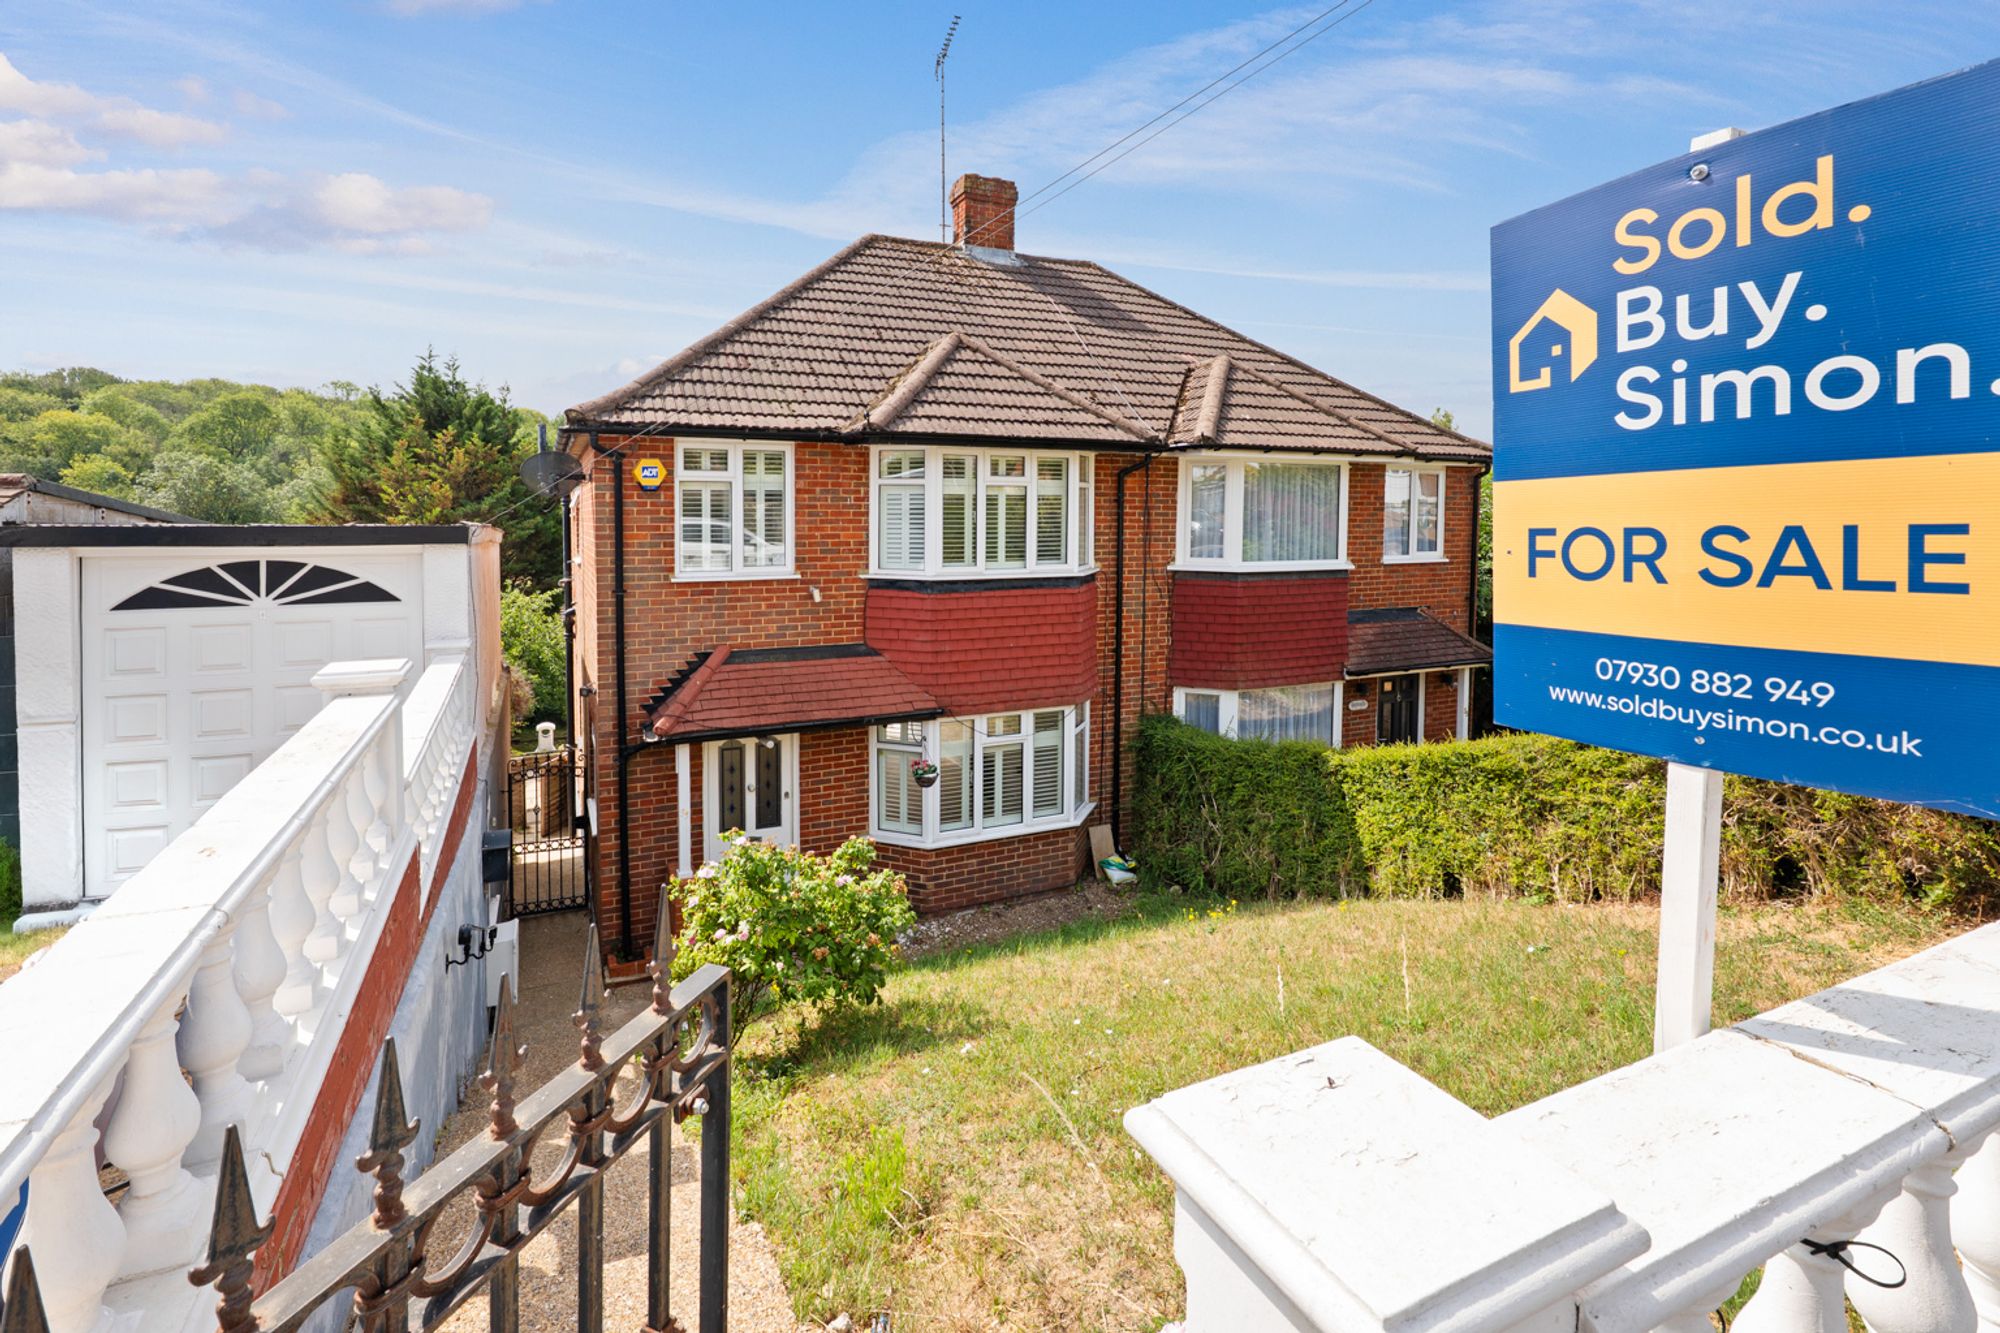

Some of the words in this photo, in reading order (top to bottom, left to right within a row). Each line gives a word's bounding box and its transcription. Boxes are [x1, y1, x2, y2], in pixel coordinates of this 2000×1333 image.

[1612, 154, 1872, 275] Sold.
[1616, 271, 1828, 353] Buy.
[642, 467, 658, 477] ADT
[1528, 527, 1668, 584] FOR
[1698, 524, 1970, 594] SALE
[1595, 657, 1681, 690] 07930
[1690, 669, 1753, 699] 882
[1764, 676, 1835, 708] 949
[1549, 685, 1922, 757] www.soldbuysimon.co.uk
